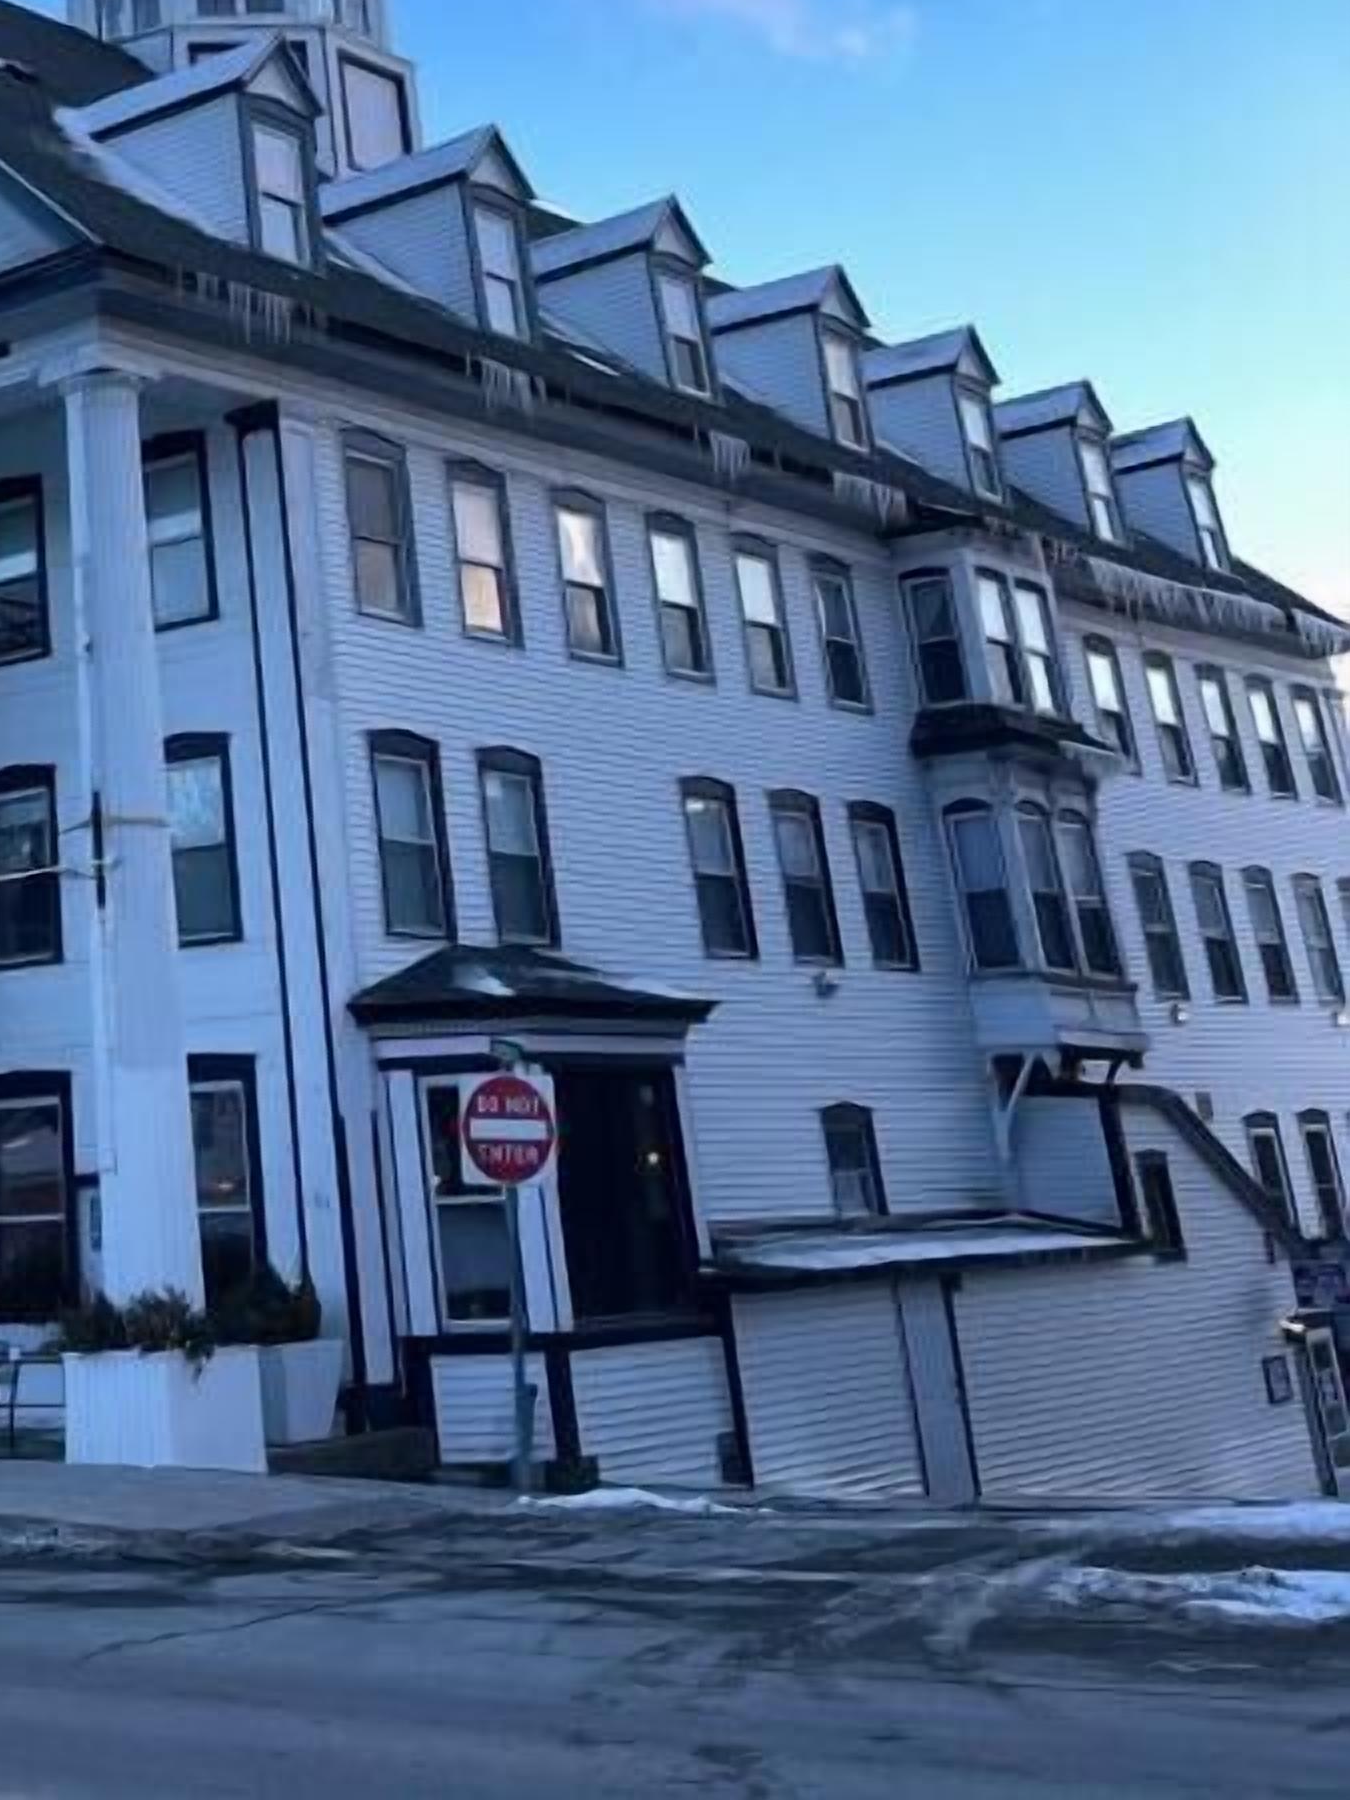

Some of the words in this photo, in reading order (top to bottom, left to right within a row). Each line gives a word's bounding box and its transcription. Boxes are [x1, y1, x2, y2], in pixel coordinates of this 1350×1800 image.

[478, 1095, 499, 1113] DO
[505, 1095, 539, 1114] NOT
[478, 1143, 539, 1165] ENTER
